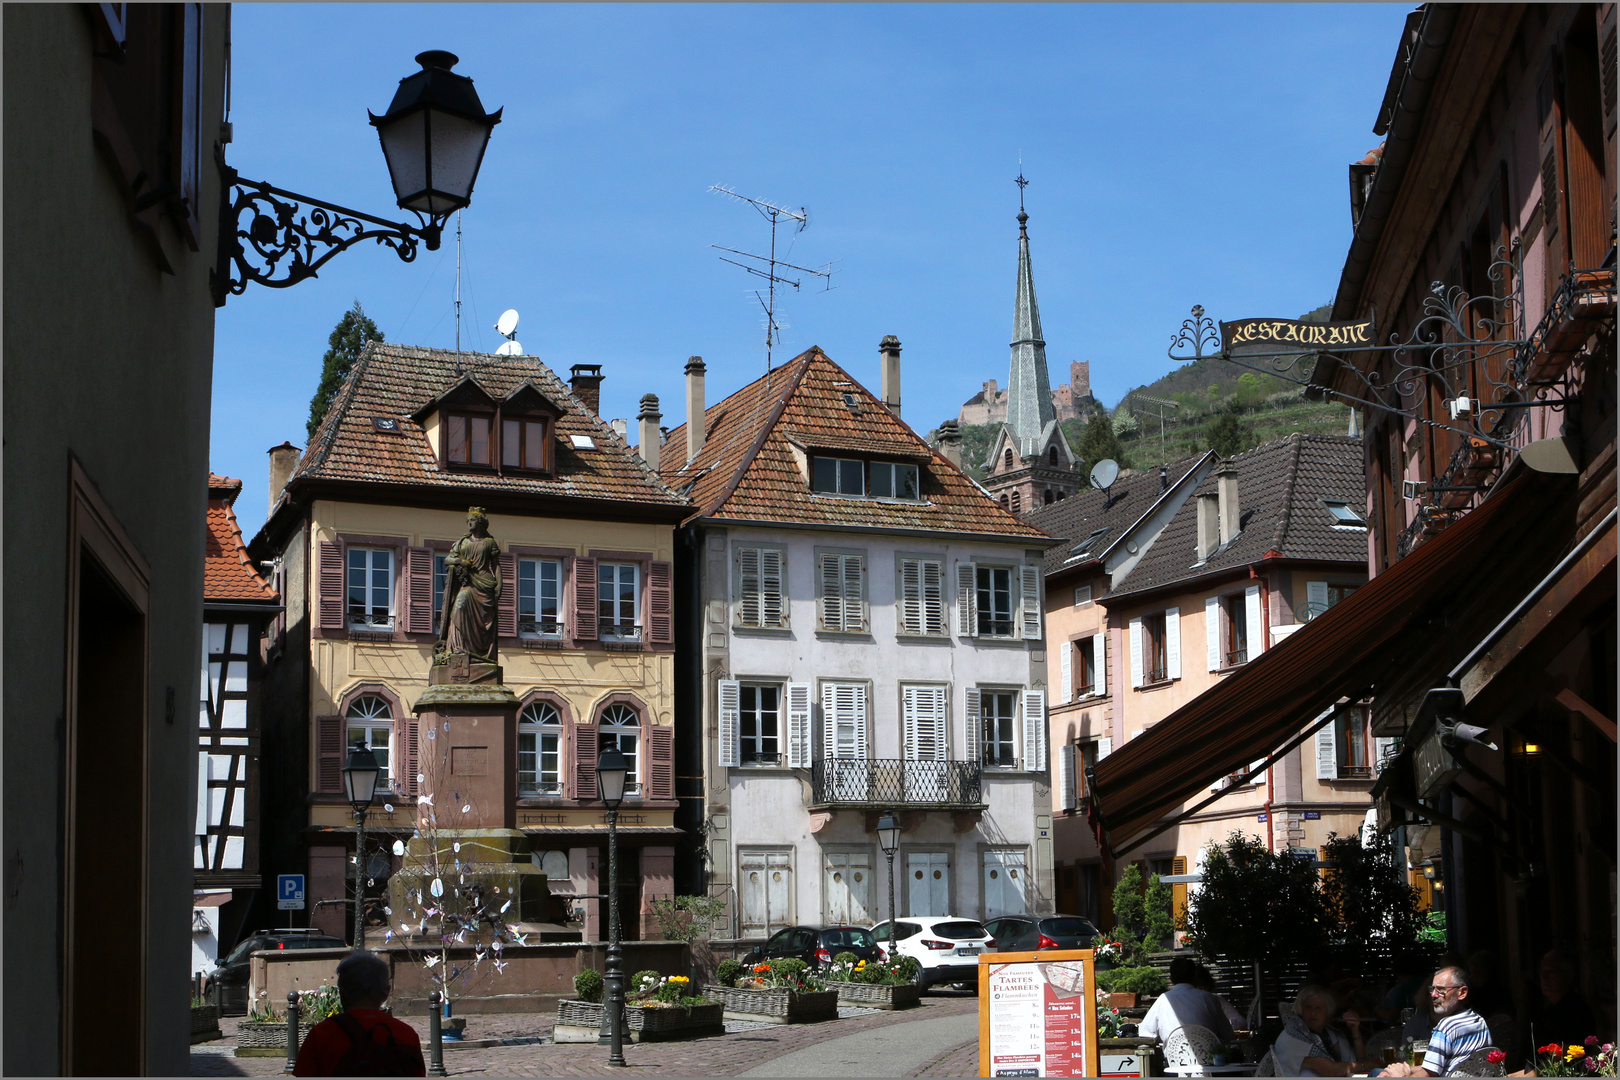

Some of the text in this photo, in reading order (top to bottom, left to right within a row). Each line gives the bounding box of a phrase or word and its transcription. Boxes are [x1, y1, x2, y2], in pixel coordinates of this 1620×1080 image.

[1228, 321, 1371, 345] RESTAURANT
[285, 880, 296, 896] P
[993, 983, 1039, 991] FLAMBÉES
